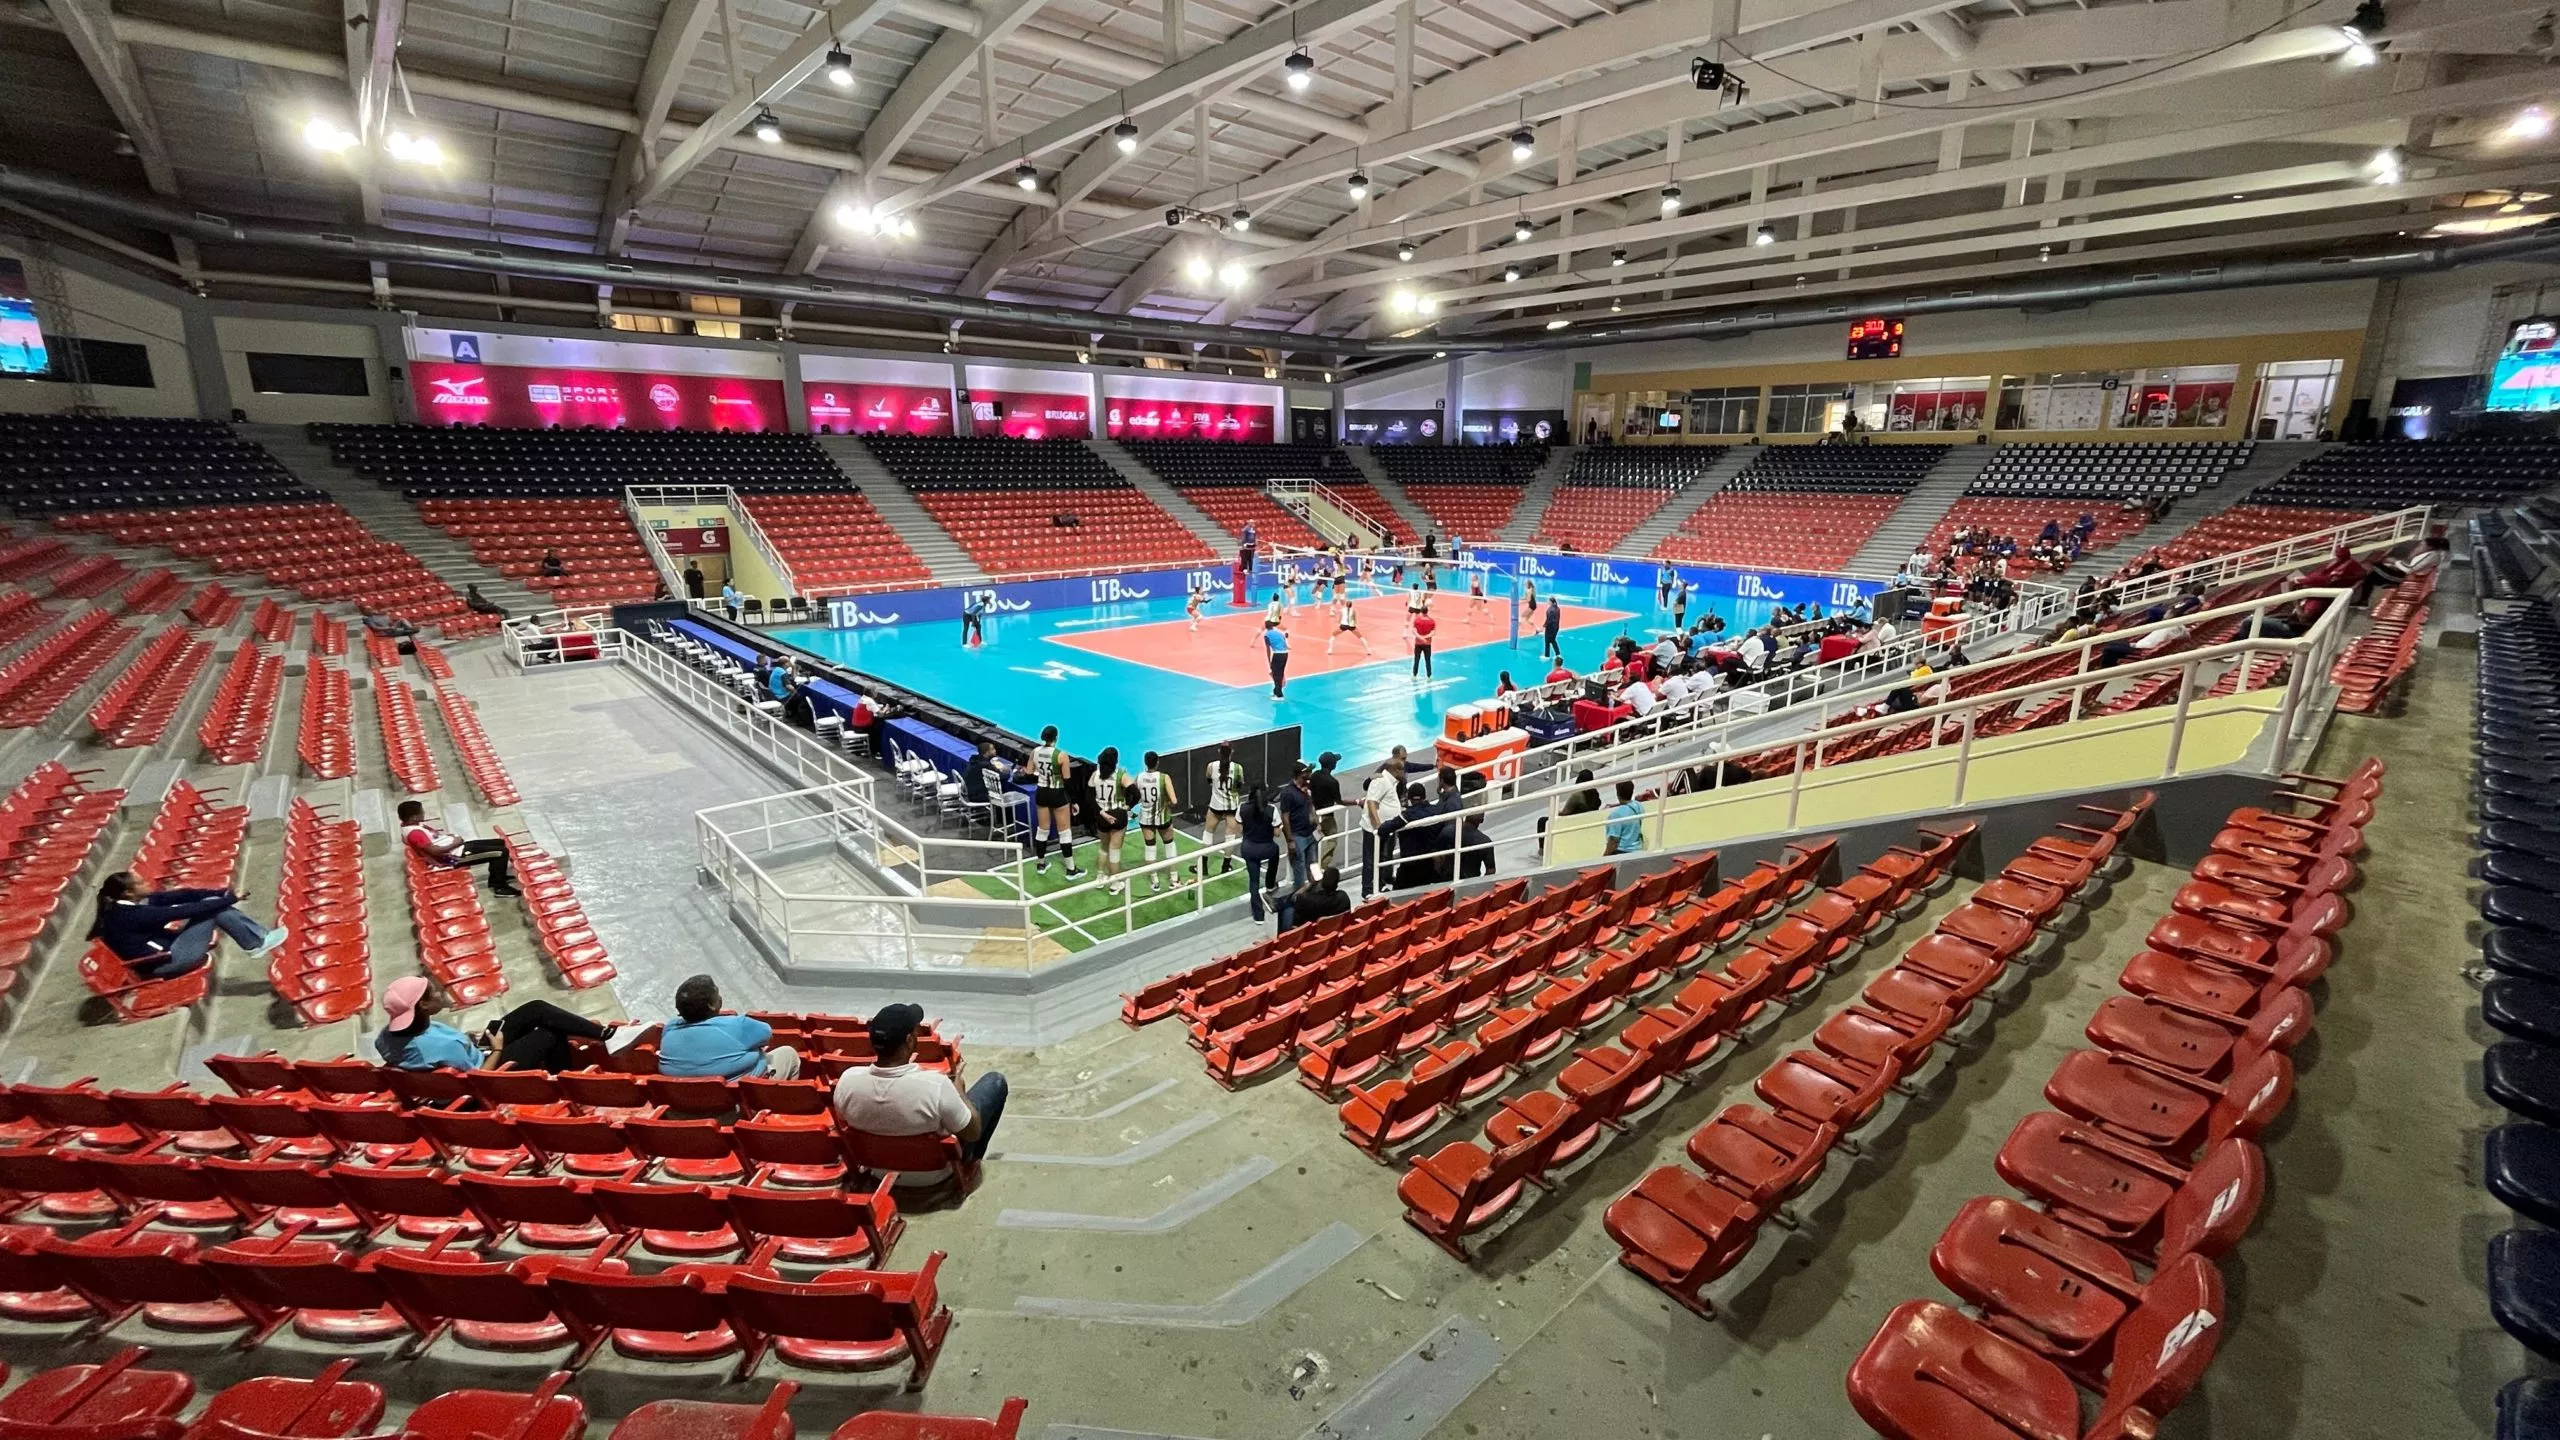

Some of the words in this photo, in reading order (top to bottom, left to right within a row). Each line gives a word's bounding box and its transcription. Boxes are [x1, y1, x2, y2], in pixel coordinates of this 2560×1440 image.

[456, 341, 478, 358] A
[562, 386, 619, 395] SPORT
[2104, 380, 2115, 390] G
[563, 395, 620, 403] COURT
[1045, 410, 1079, 421] BRUGAL
[702, 530, 716, 544] G
[1519, 556, 1537, 576] LTB
[1591, 562, 1610, 582] LTB
[1091, 579, 1120, 602] LTB
[1187, 571, 1212, 593] LTB
[1738, 575, 1761, 597] LTB
[1832, 583, 1858, 607] LTB
[827, 601, 858, 628] TB
[1039, 761, 1053, 776] 33
[1492, 748, 1513, 782] G
[1099, 784, 1114, 801] 17
[1142, 787, 1158, 804] 19
